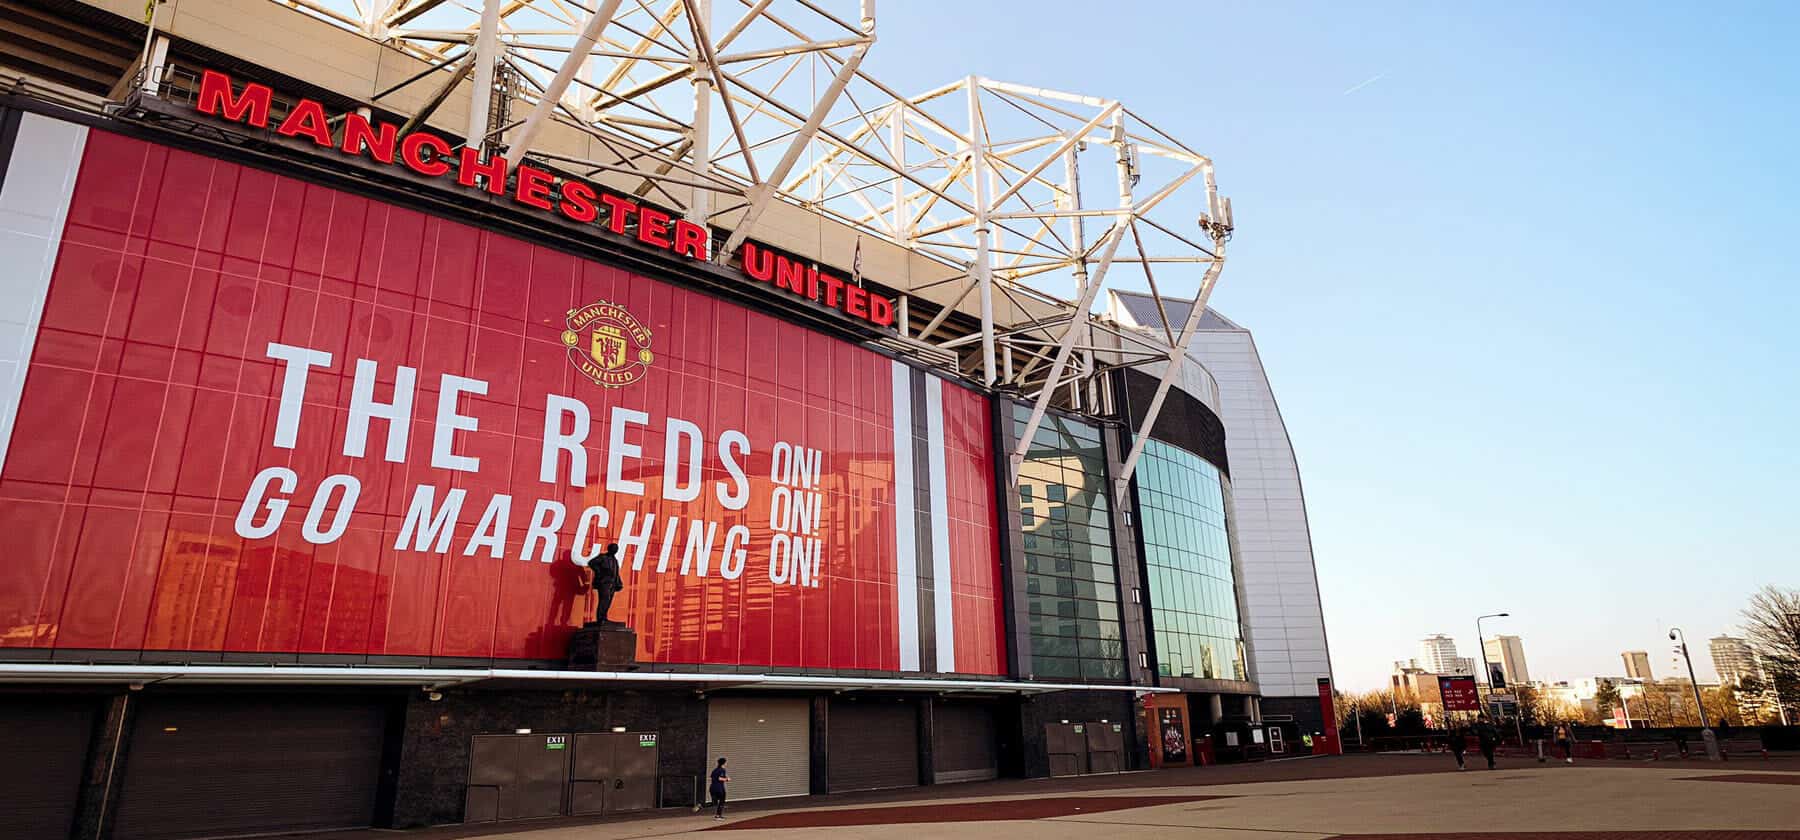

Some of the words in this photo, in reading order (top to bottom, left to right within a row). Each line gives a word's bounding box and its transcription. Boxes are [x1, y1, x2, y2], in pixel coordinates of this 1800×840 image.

[197, 69, 708, 262] MANCHESTER
[741, 242, 894, 327] UNITED
[573, 307, 646, 343] MANCHESTER
[582, 362, 633, 382] UNITED
[266, 342, 489, 473] THE
[539, 393, 751, 510] REDS
[771, 441, 822, 492] ON!
[234, 466, 362, 545] GO
[394, 484, 750, 580] MARCHING
[769, 486, 821, 537] ON!
[768, 533, 821, 588] ON!
